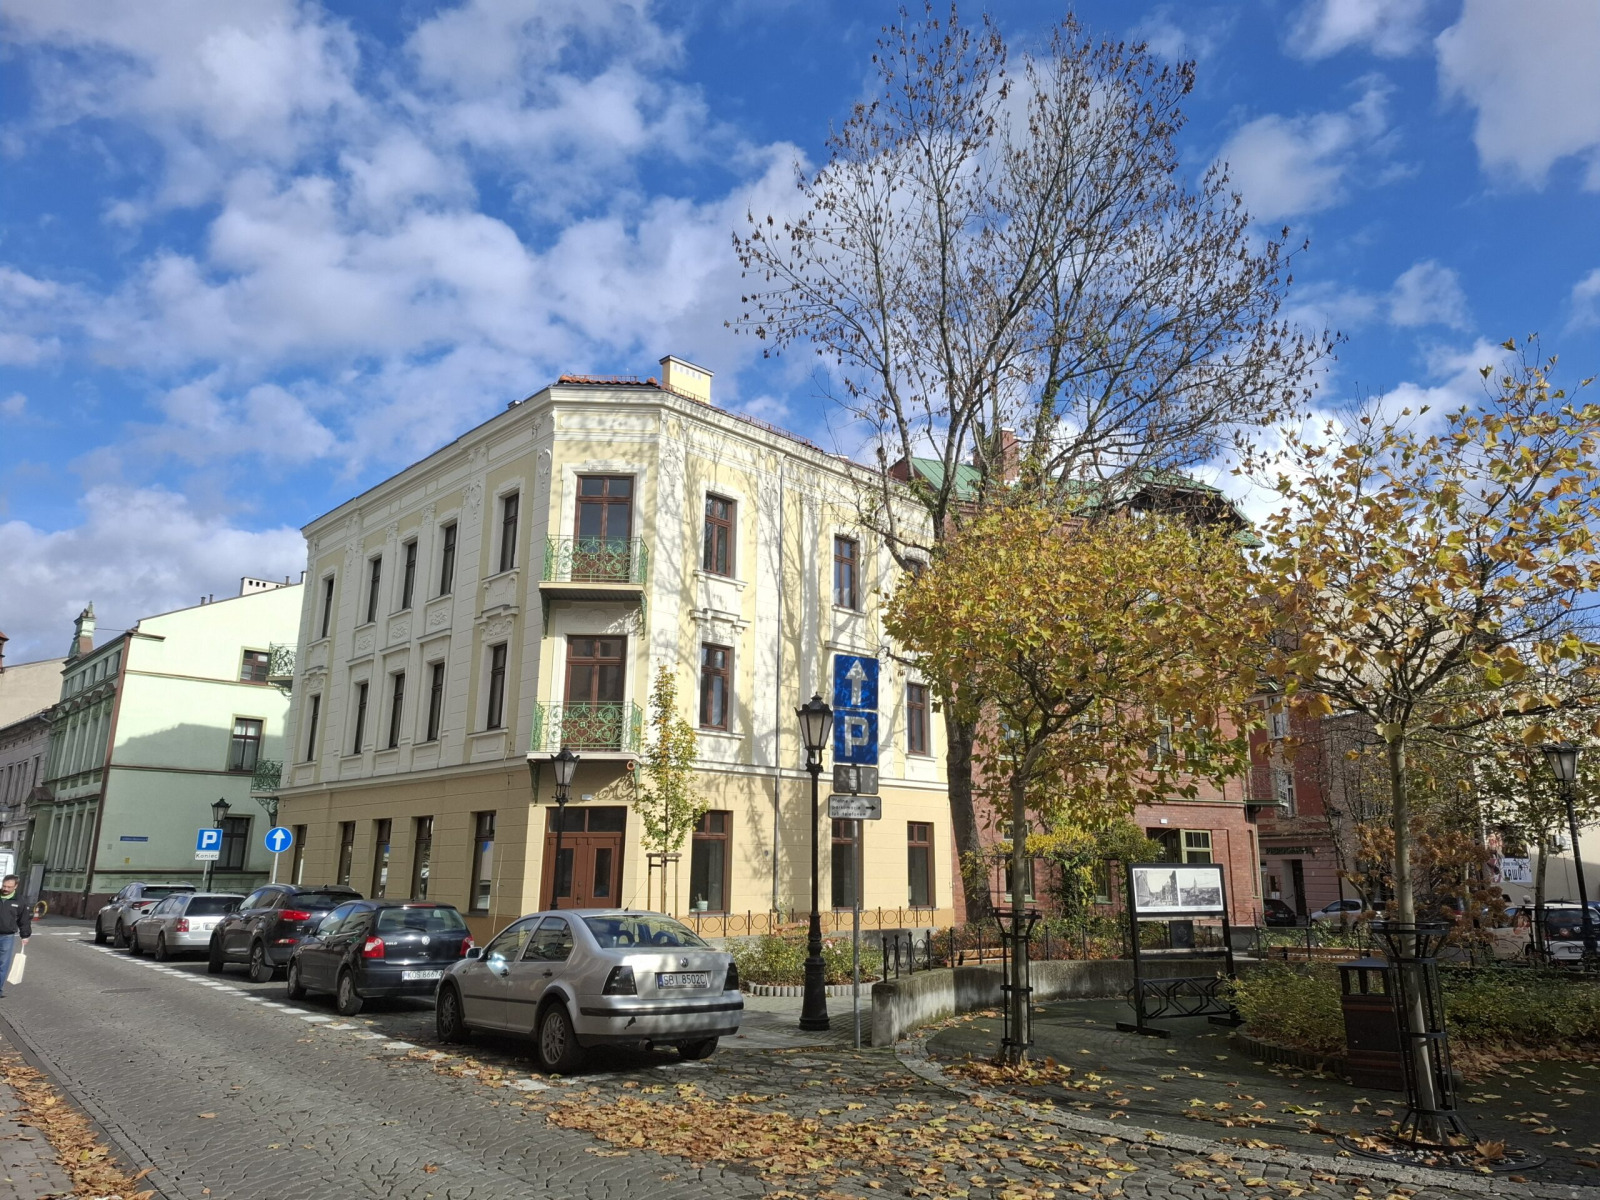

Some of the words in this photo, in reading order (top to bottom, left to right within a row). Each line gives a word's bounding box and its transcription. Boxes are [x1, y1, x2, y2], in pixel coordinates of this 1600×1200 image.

[844, 715, 869, 757] P
[201, 831, 218, 849] P
[195, 852, 218, 860] Koniec
